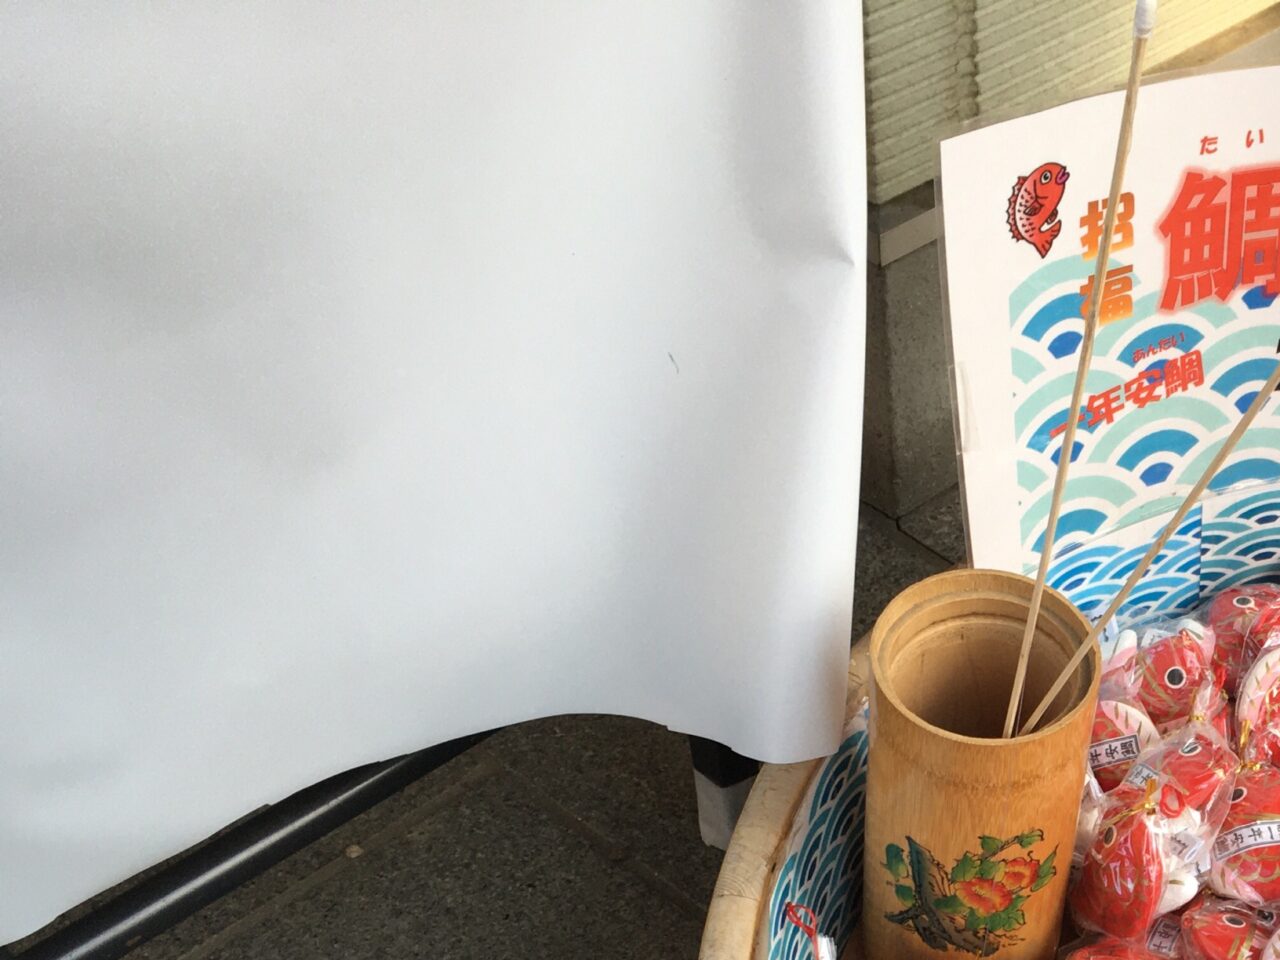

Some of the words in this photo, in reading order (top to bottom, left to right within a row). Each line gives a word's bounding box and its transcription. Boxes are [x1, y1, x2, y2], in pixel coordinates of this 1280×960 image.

[1200, 129, 1264, 154] たい
[1049, 350, 1205, 438] 一年安鯛
